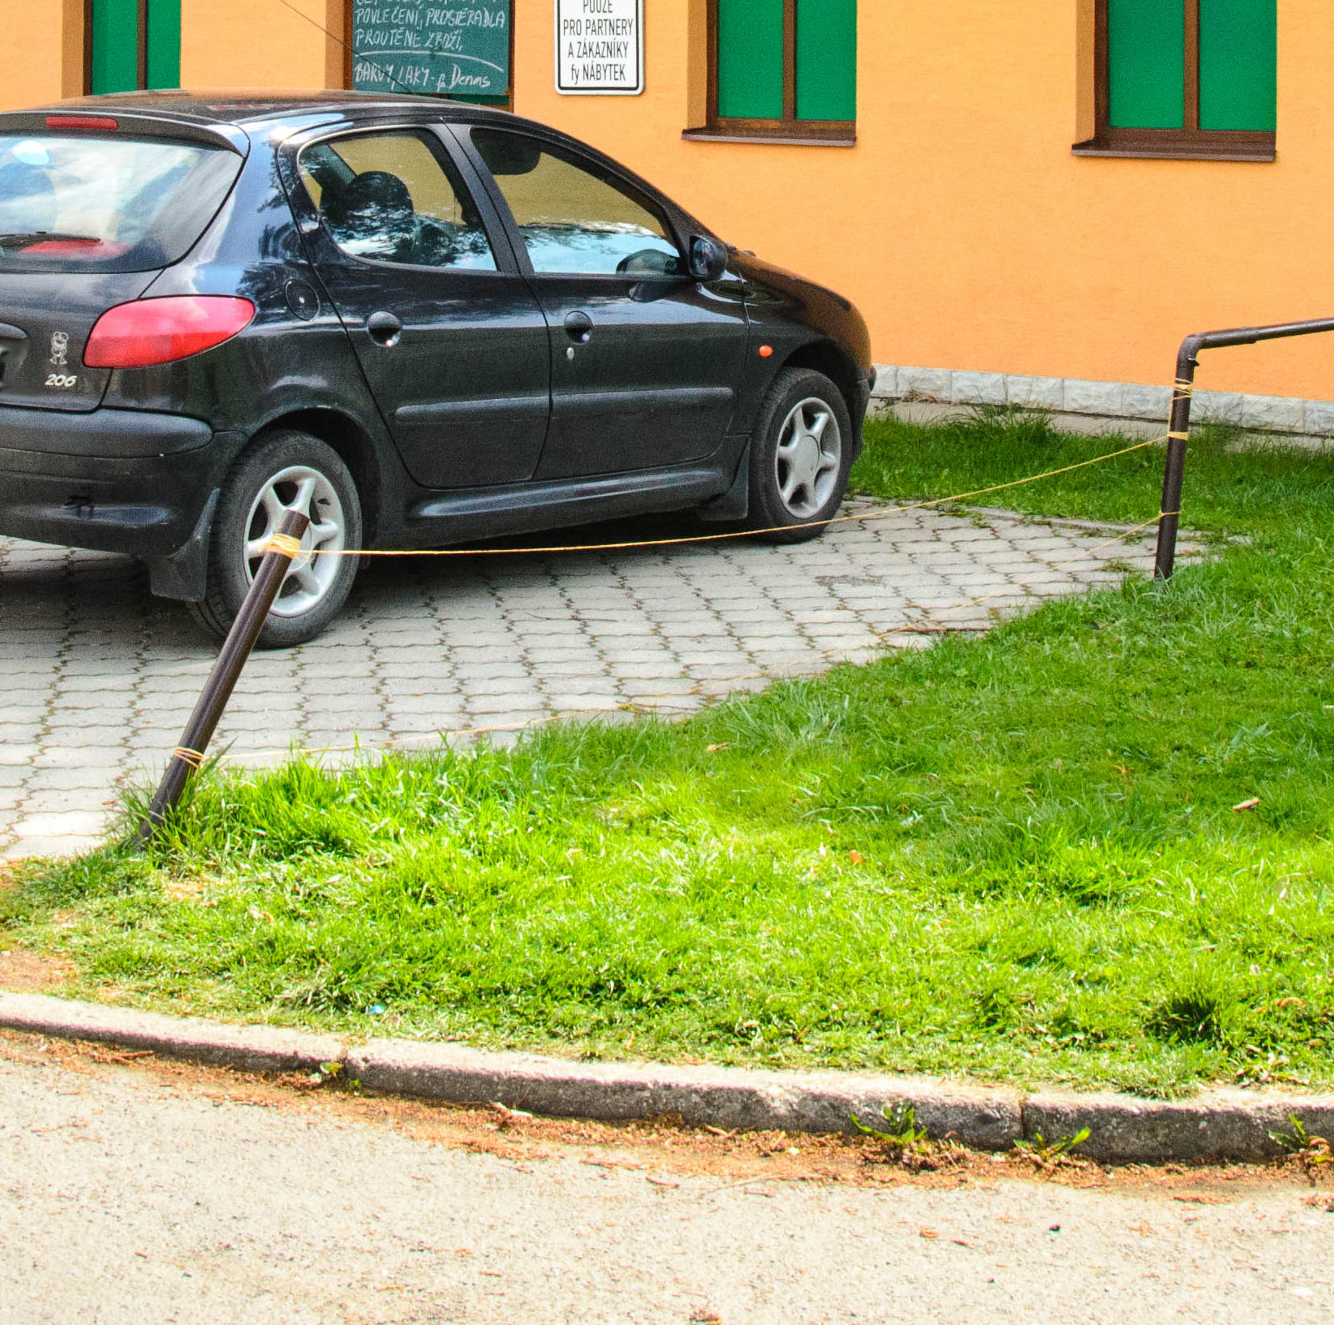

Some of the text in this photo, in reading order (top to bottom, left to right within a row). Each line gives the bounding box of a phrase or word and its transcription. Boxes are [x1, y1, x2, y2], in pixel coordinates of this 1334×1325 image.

[563, 18, 634, 36] PRO PARTNERY
[568, 38, 629, 59] A ZÁKAZNÍKY
[571, 60, 626, 85] fy NÁBYTEK
[45, 374, 77, 387] 206
